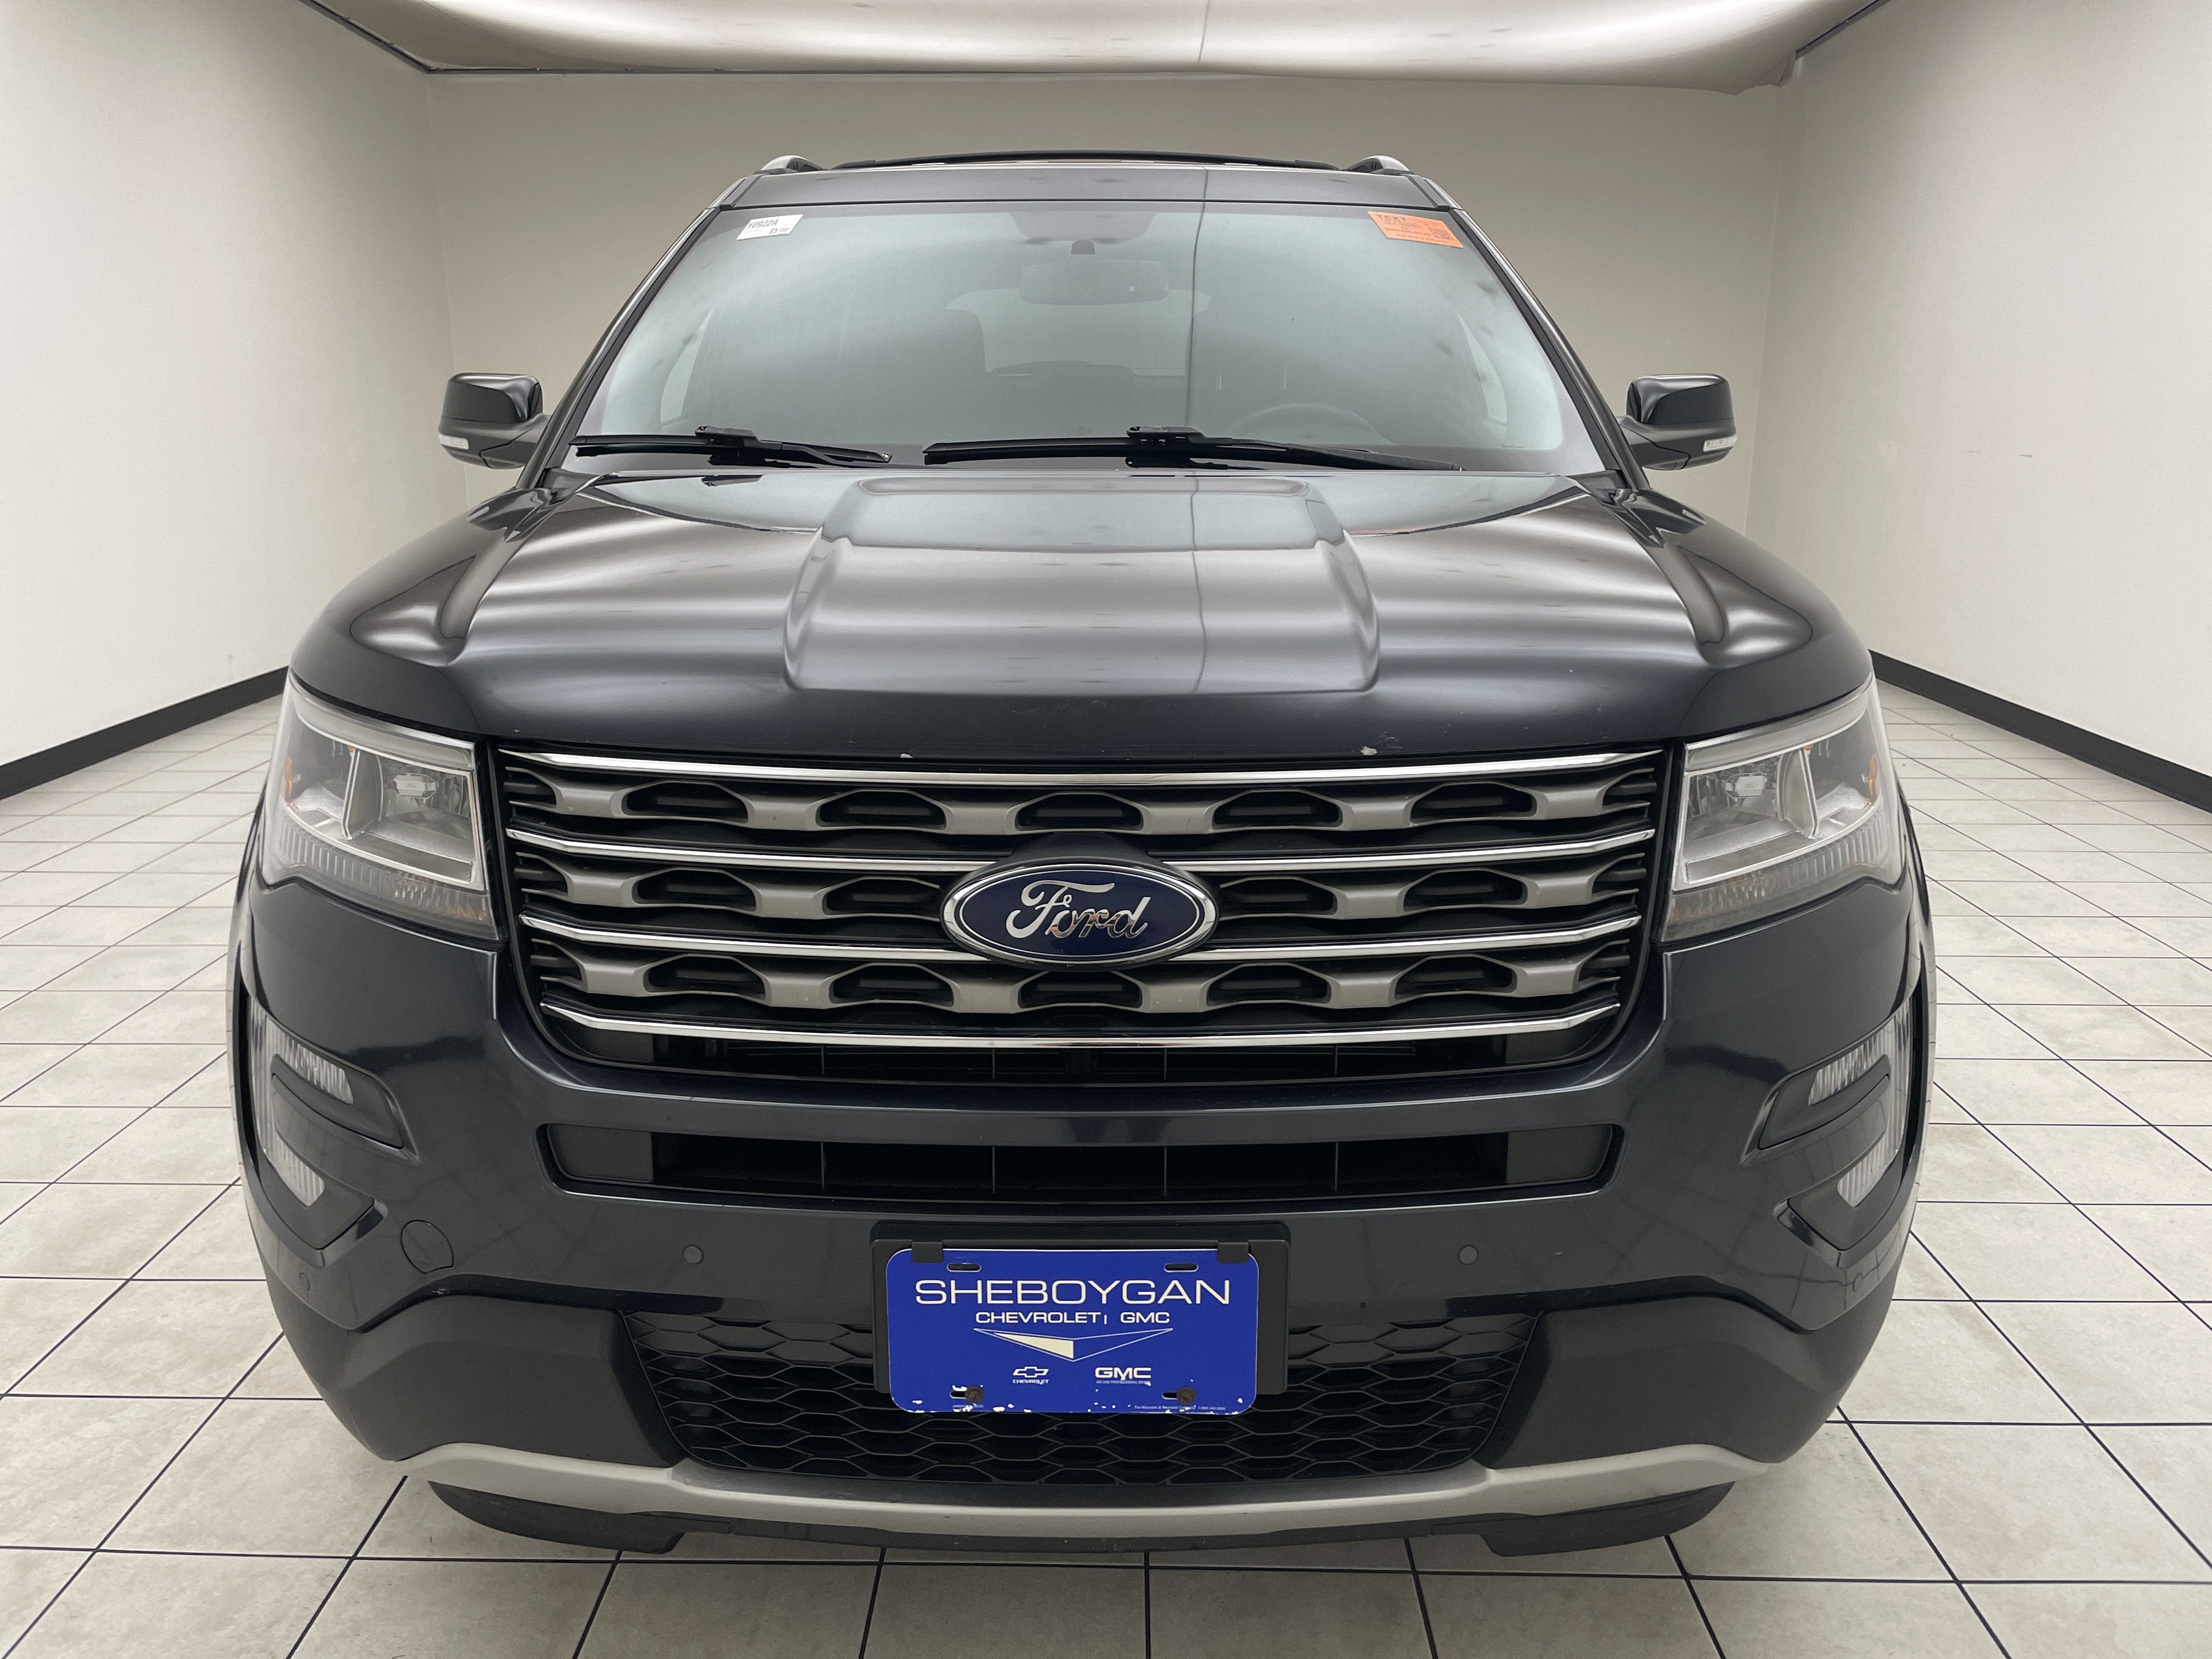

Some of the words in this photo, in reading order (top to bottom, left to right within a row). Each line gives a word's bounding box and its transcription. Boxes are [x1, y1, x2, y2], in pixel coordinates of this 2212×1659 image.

[1006, 880, 1151, 938] Ford
[916, 1279, 1230, 1305] SHEBOYGAN
[975, 1312, 1101, 1323] CHEVROLET
[1120, 1312, 1170, 1323] GMC
[1095, 1367, 1152, 1379] GMC
